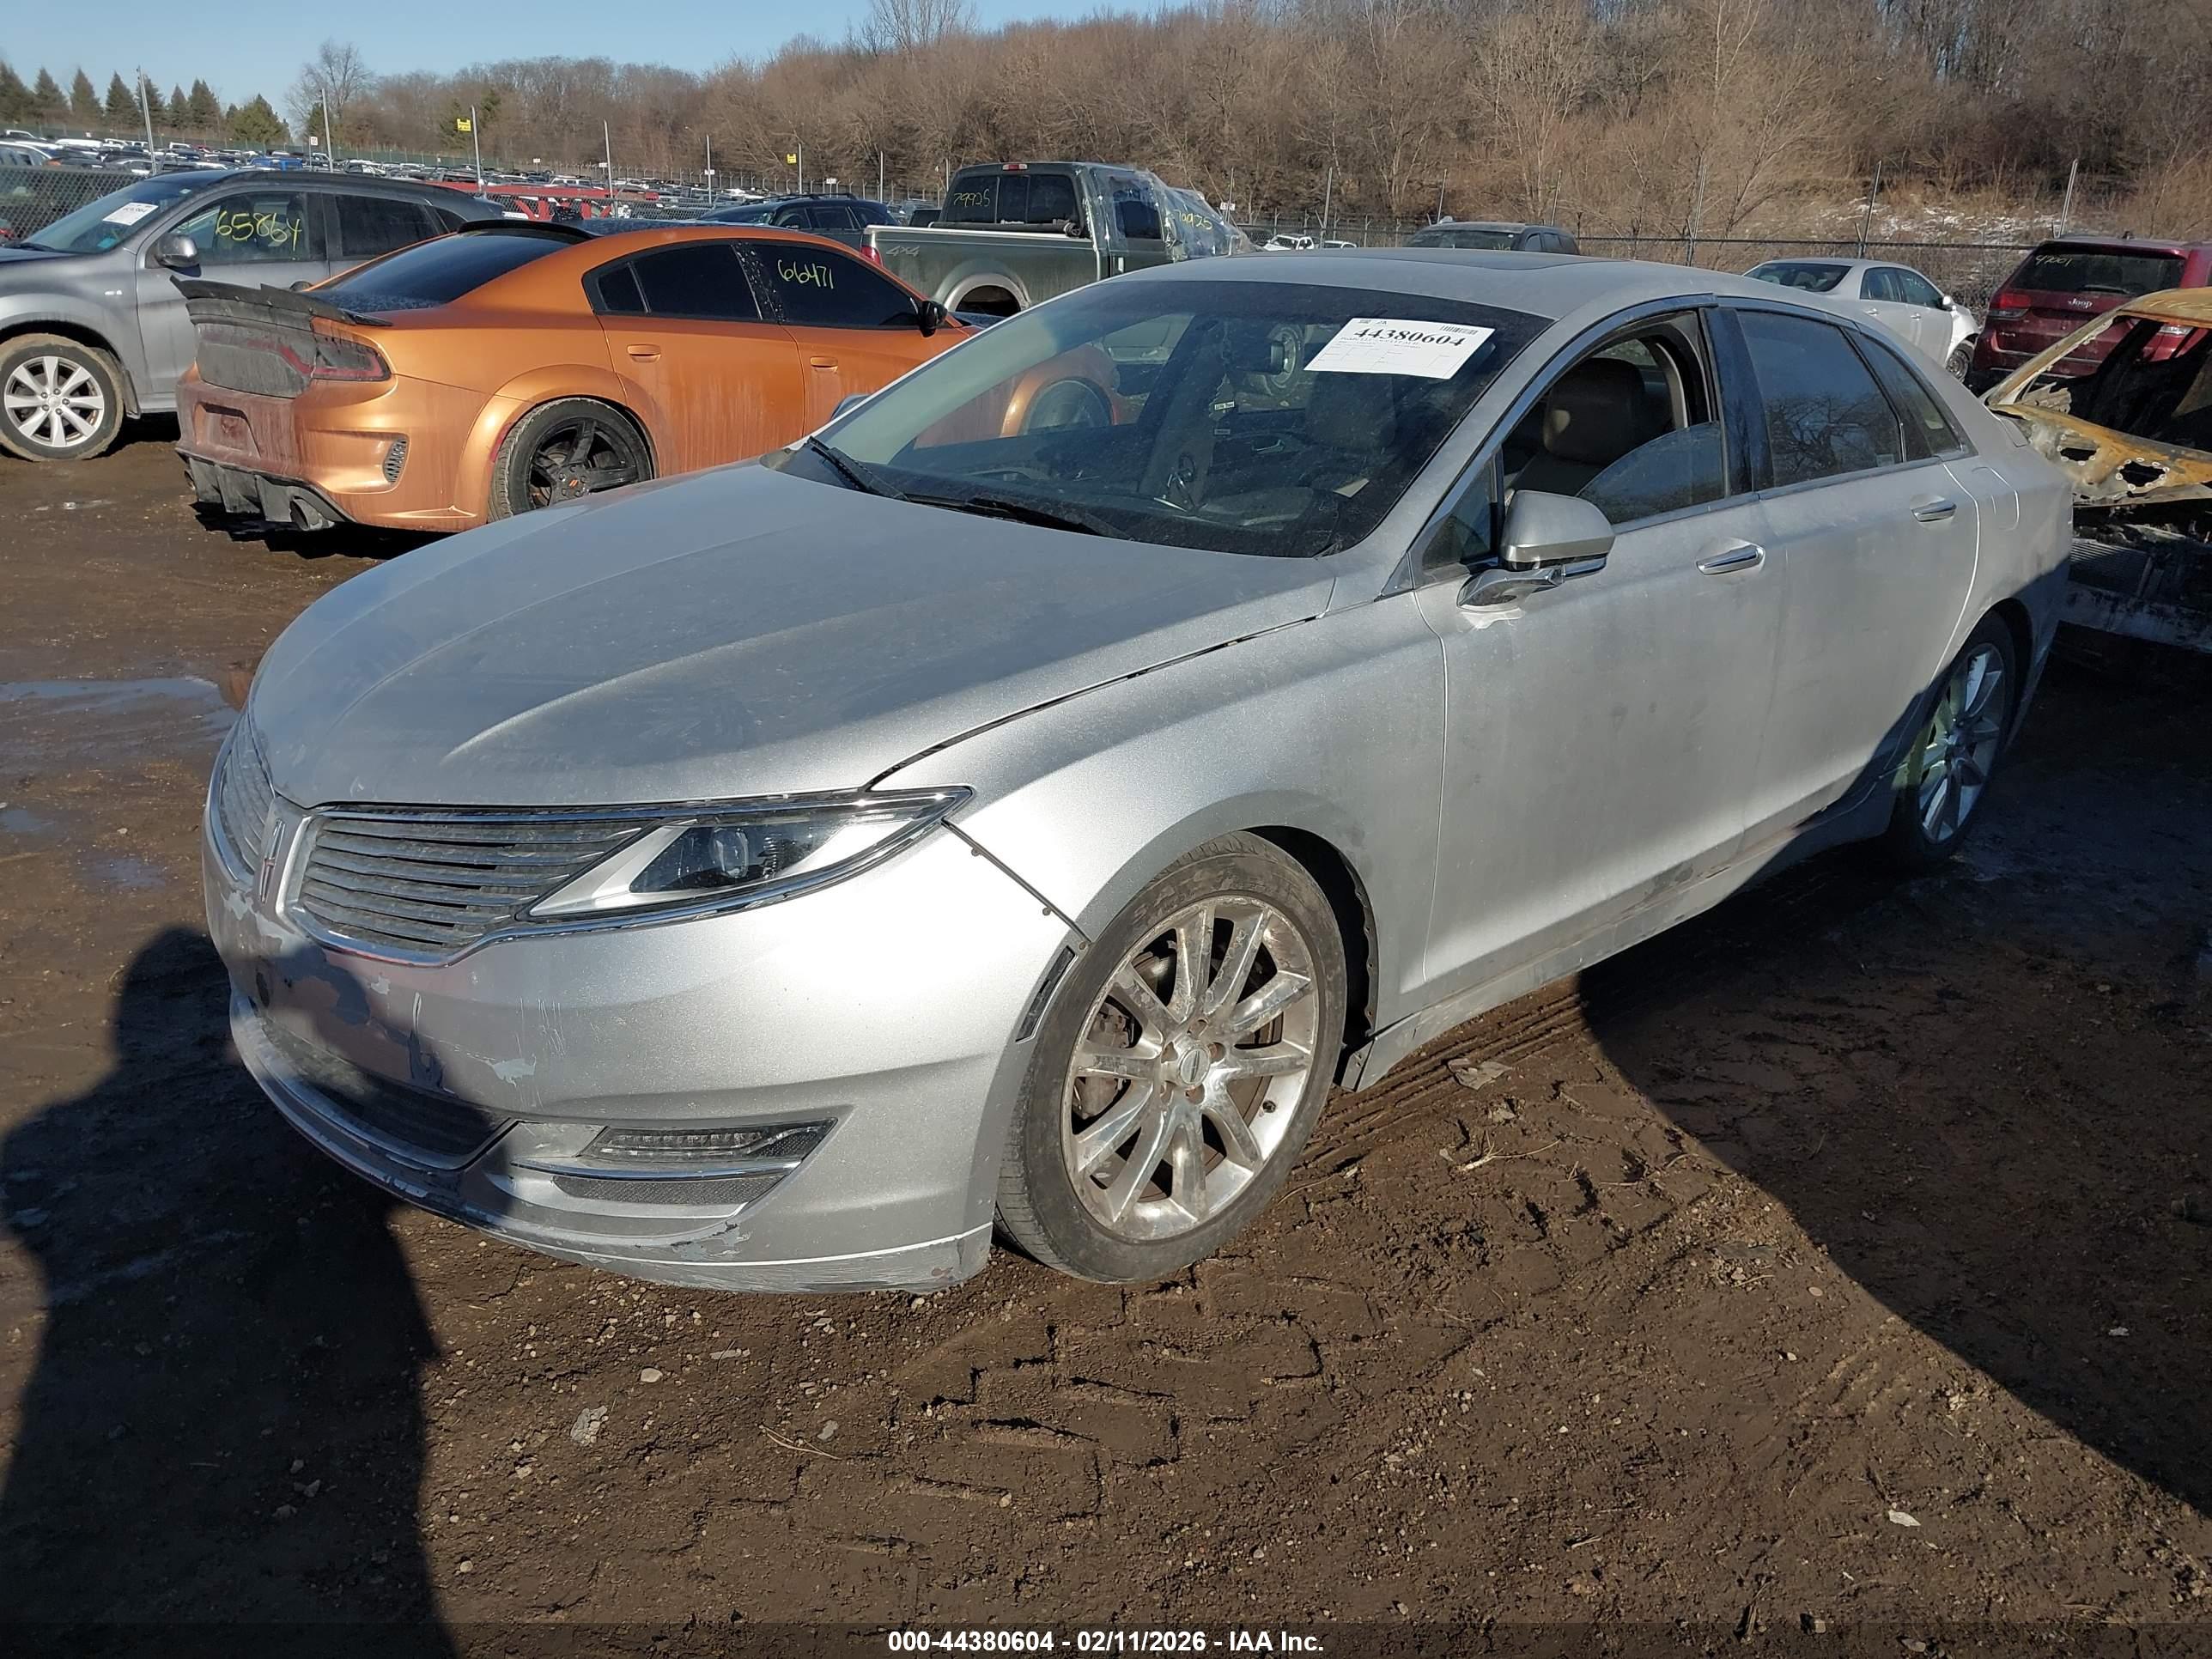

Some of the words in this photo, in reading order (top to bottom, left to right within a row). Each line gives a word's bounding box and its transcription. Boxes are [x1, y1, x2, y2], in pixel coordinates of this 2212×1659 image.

[216, 210, 303, 252] 65864
[777, 259, 834, 289] 66471
[1354, 327, 1467, 347] 44380604
